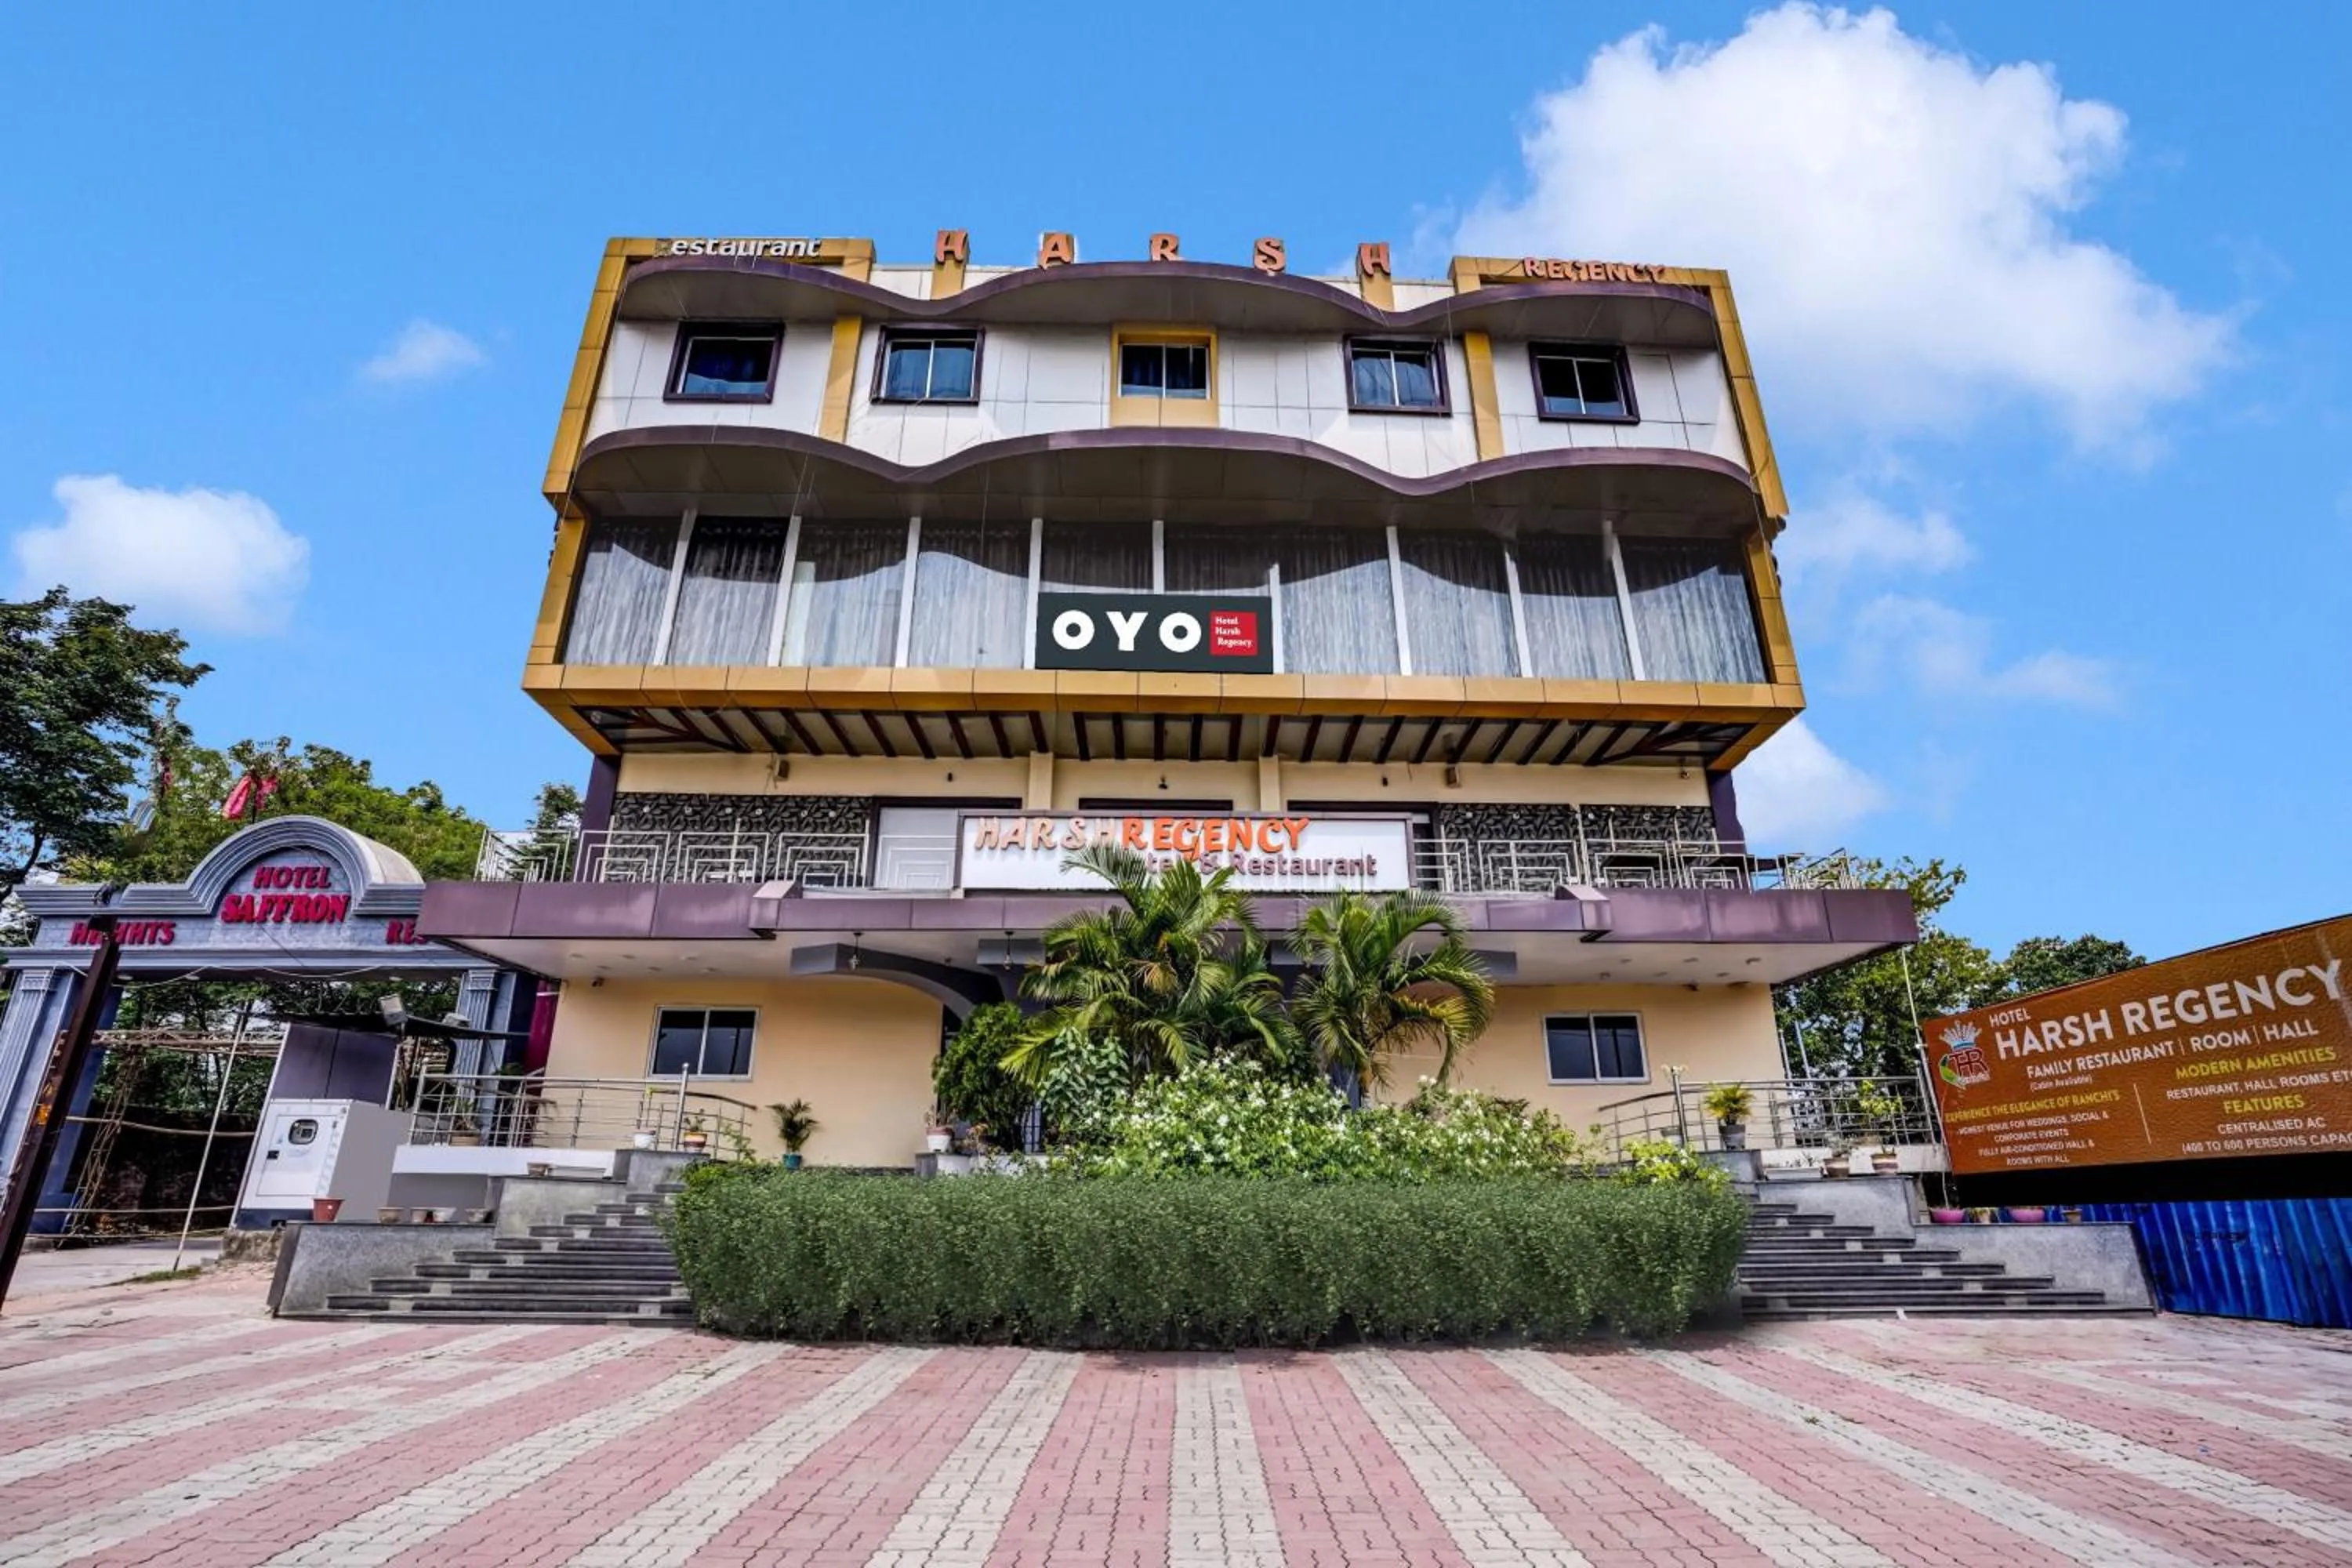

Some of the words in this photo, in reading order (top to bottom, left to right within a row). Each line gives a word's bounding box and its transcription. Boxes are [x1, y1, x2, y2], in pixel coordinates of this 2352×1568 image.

[1523, 256, 1665, 283] REGENCY
[1052, 609, 1202, 653] OYO
[1215, 615, 1239, 625] Hotel
[1215, 626, 1241, 636] Harsh
[975, 816, 1116, 850] HARSH
[1122, 815, 1309, 862] REGENCY
[1229, 851, 1377, 877] Restaurant
[253, 866, 332, 889] HOTEL
[221, 893, 351, 924] SAFFRON
[1989, 1007, 2031, 1028] HOTEL
[1994, 1008, 2114, 1060] HARSH
[2120, 959, 2343, 1036] REGENCY
[2027, 1058, 2073, 1079] FAMILY
[2076, 1040, 2175, 1071] RESTAURANT
[2190, 1026, 2251, 1053] ROOM
[2263, 1019, 2319, 1042] HALL
[2176, 1059, 2242, 1080] MODERN
[2245, 1047, 2337, 1071] AMENITIES
[2245, 1079, 2277, 1091] HALL
[2279, 1073, 2329, 1087] ROOMS
[1945, 1105, 1991, 1123] EXPERIENCE
[1992, 1103, 2009, 1115] THE
[2009, 1098, 2056, 1113] ELEGANCE
[2056, 1096, 2070, 1107] OF
[2223, 1094, 2306, 1114] FEATURES
[2071, 1112, 2101, 1123] SOCIAL
[2217, 1118, 2303, 1134] CENTRALISED
[2307, 1116, 2327, 1129] AC
[2206, 1141, 2221, 1152] TO
[2245, 1134, 2307, 1149] PERSONS
[2033, 1155, 2053, 1164] WITH
[2054, 1153, 2070, 1163] ALL
